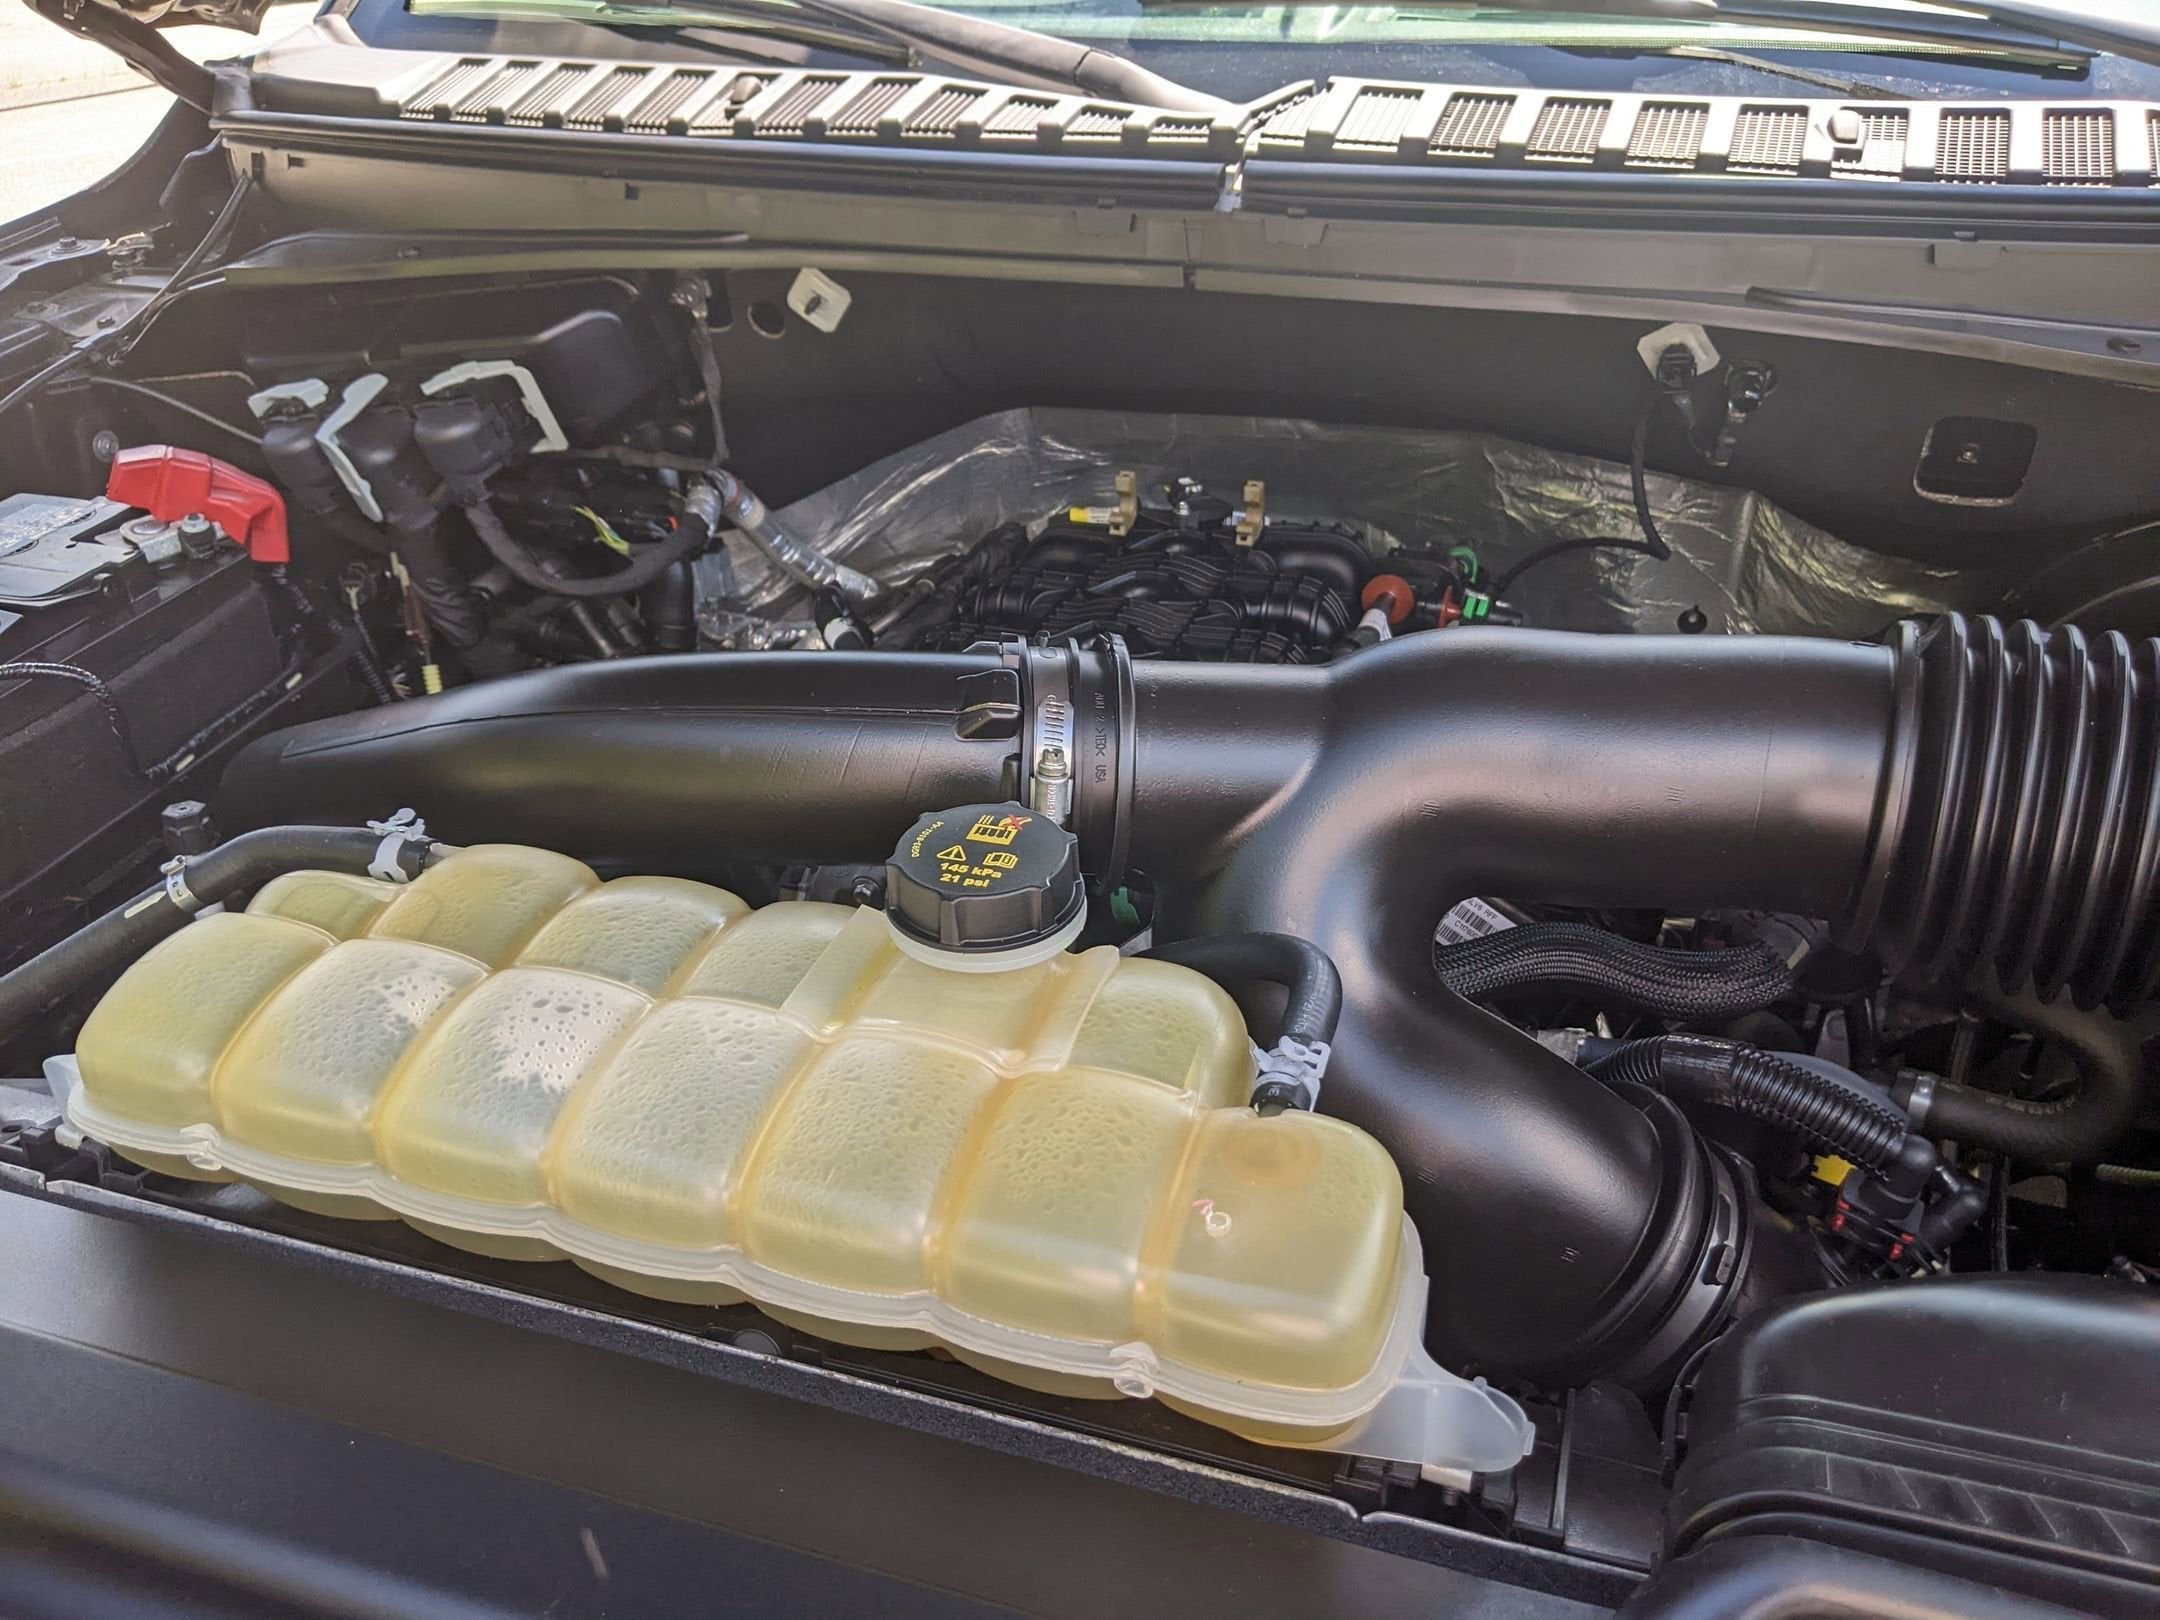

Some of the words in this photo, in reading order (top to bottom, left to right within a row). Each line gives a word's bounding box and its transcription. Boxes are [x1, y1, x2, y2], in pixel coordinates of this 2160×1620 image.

[1095, 764, 1107, 783] USA
[940, 862, 970, 874] 145
[971, 866, 1002, 879] kPa
[939, 873, 960, 883] 21
[962, 877, 991, 888] psi
